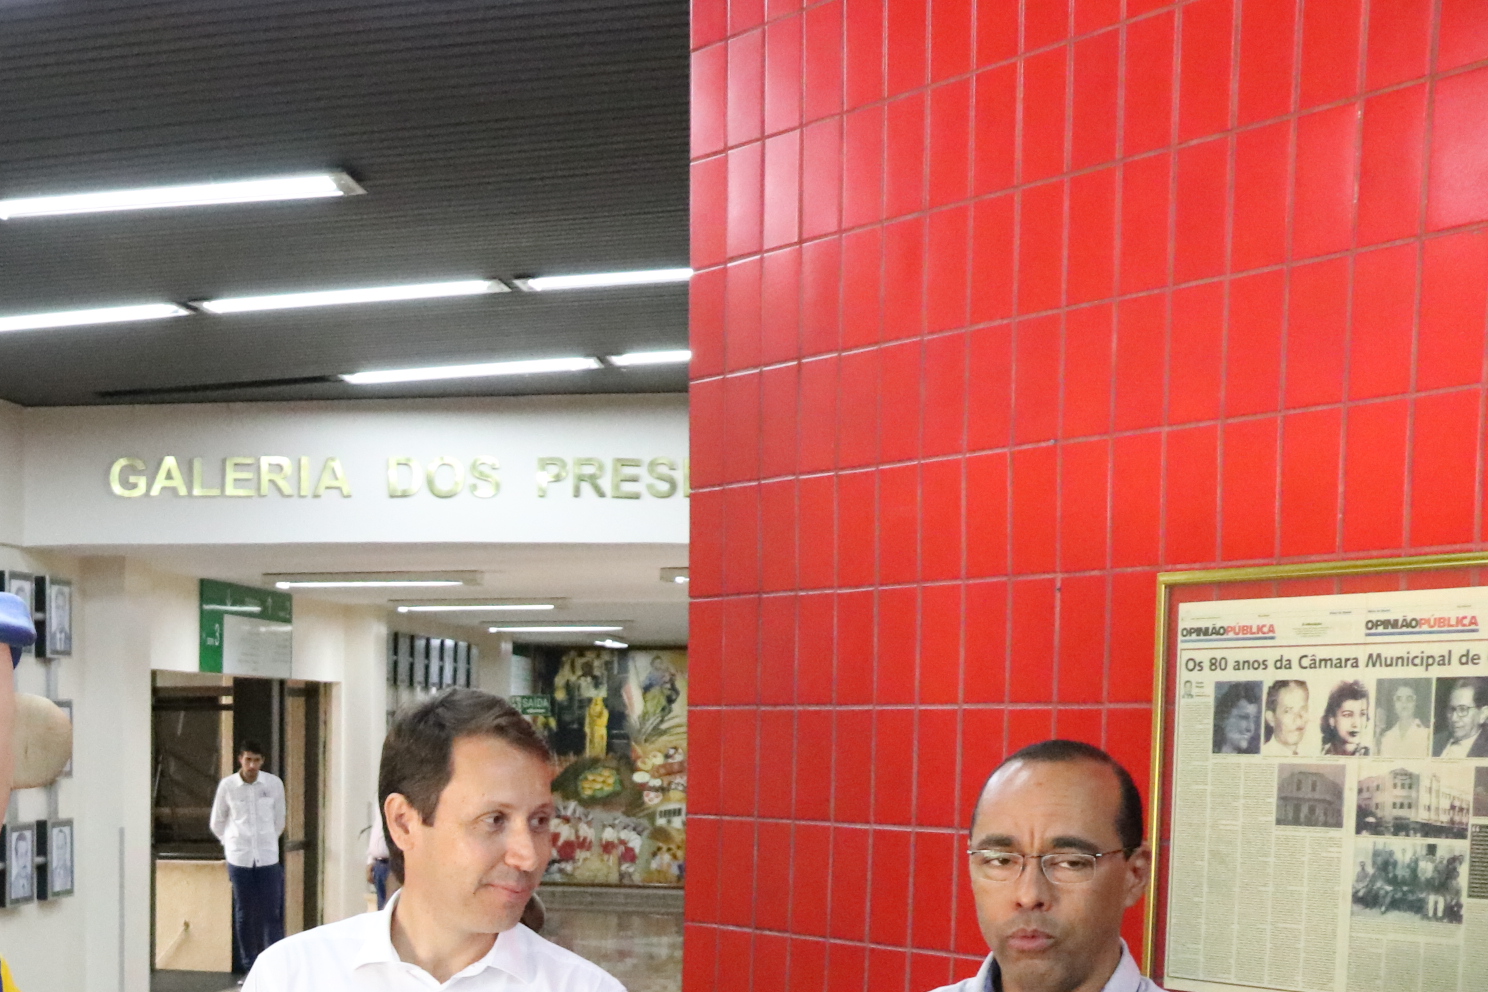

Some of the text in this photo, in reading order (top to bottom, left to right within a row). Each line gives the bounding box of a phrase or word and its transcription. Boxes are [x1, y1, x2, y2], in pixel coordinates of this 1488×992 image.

[109, 456, 352, 498] GALERIA
[387, 455, 501, 498] DOS
[1185, 648, 1481, 672] Os 80 anos da Câmara Municipal de
